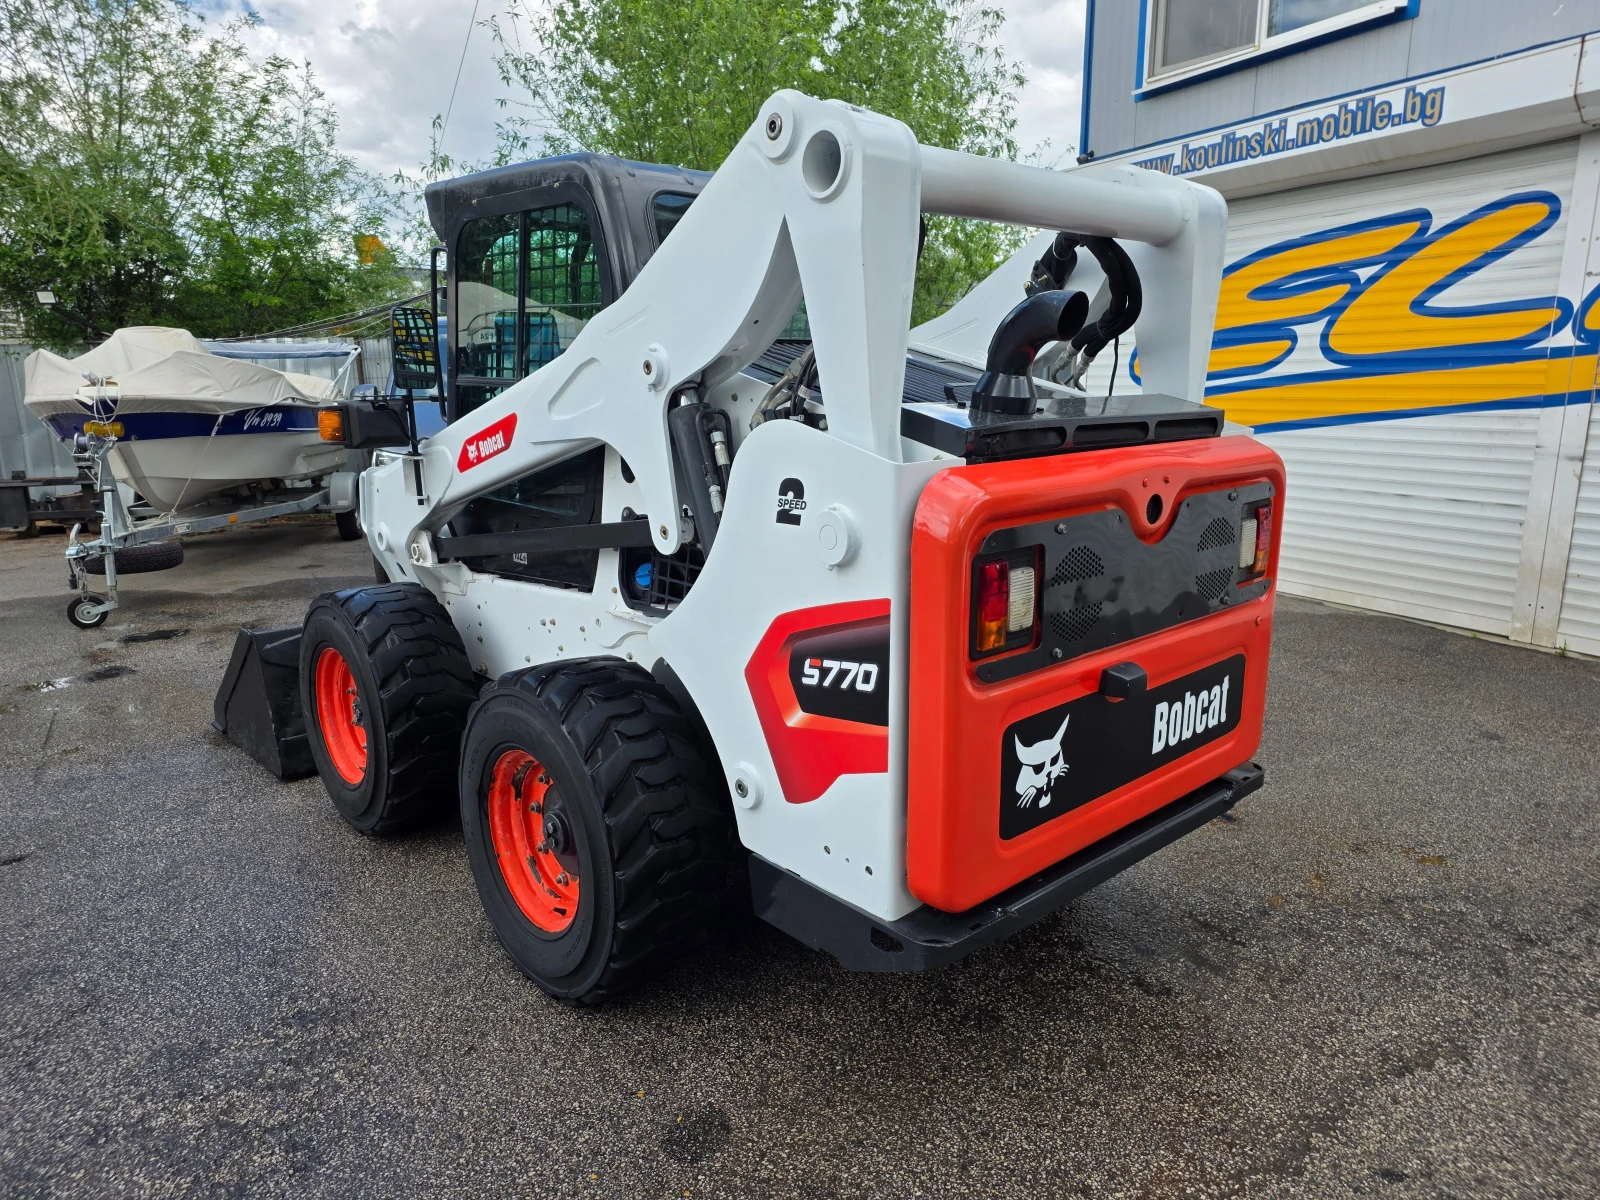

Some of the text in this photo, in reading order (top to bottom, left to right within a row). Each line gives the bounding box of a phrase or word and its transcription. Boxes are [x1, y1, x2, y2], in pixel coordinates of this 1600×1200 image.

[1134, 86, 1445, 175] w.koulinski.mobile.bg
[260, 412, 283, 427] 8939
[479, 430, 505, 458] Bobcat
[776, 478, 805, 526] 2
[777, 497, 807, 511] SPEED
[801, 658, 879, 692] S770
[1151, 674, 1230, 755] Bobcat
